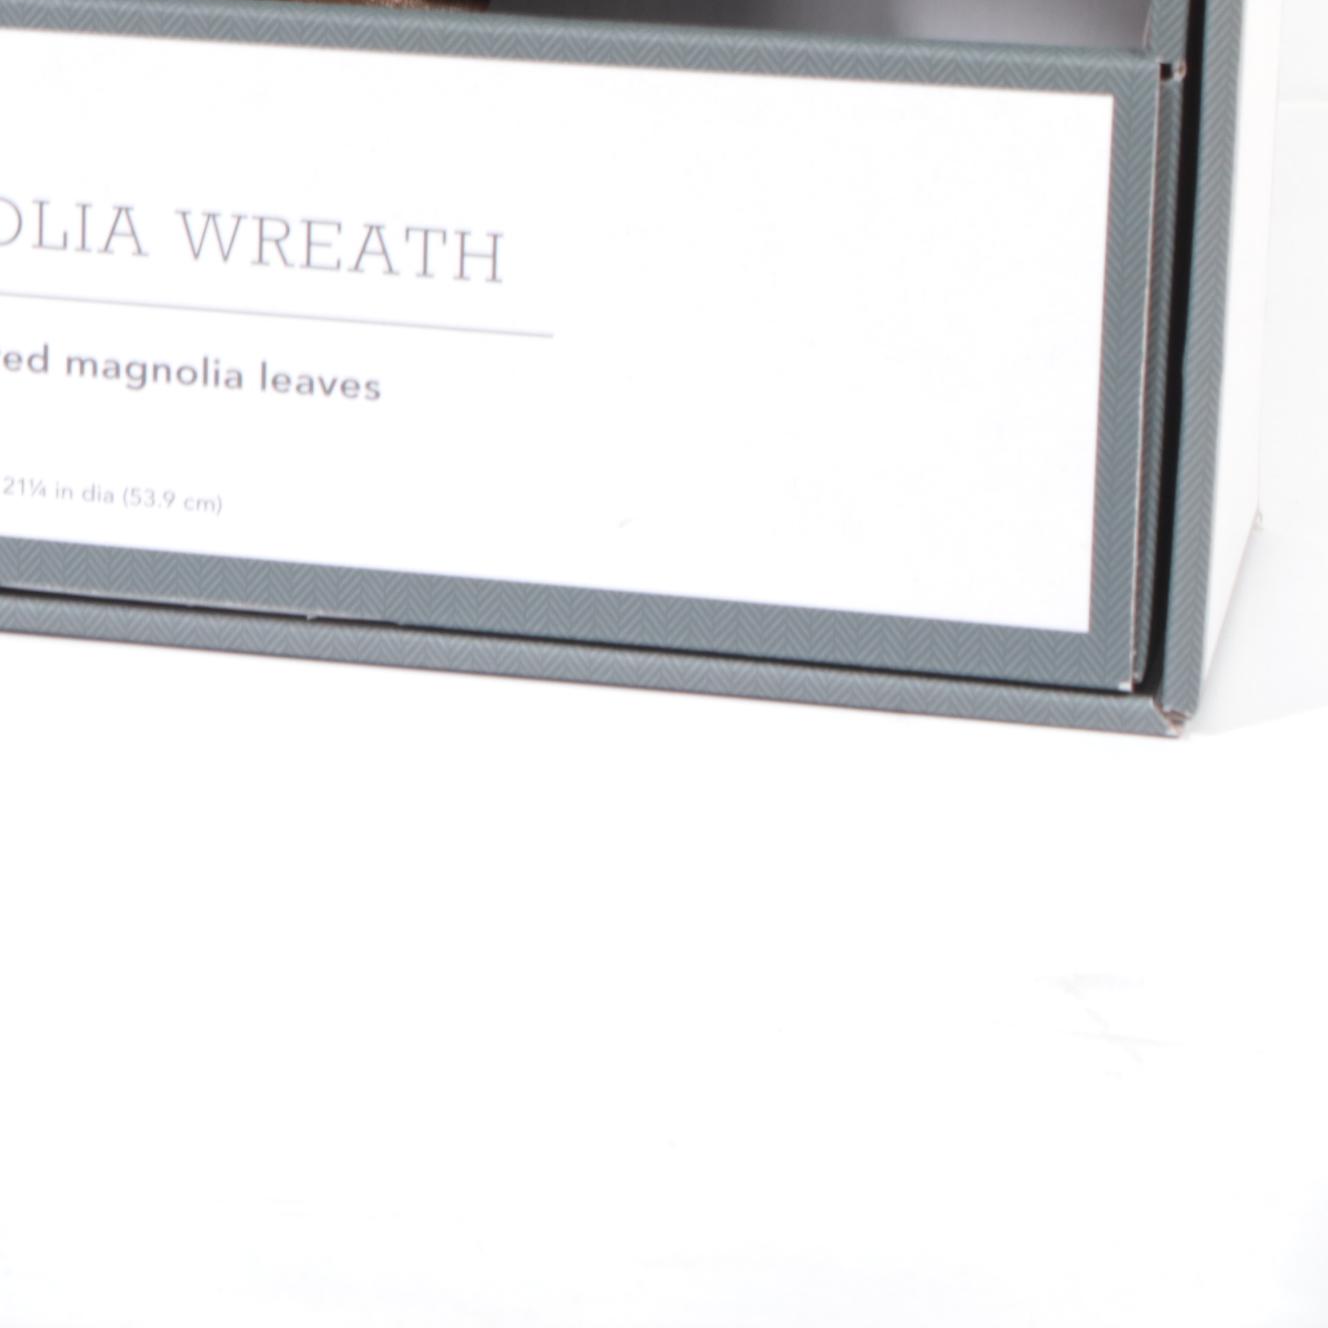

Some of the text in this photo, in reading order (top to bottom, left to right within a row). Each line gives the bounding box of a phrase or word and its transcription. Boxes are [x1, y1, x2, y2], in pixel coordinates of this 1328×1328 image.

[175, 209, 504, 284] WREATH
[65, 352, 244, 391] magnolia
[259, 360, 382, 401] leaves
[55, 481, 74, 500] in
[82, 482, 115, 504] dia
[122, 486, 176, 510] (53.9
[183, 494, 223, 517] cm)
